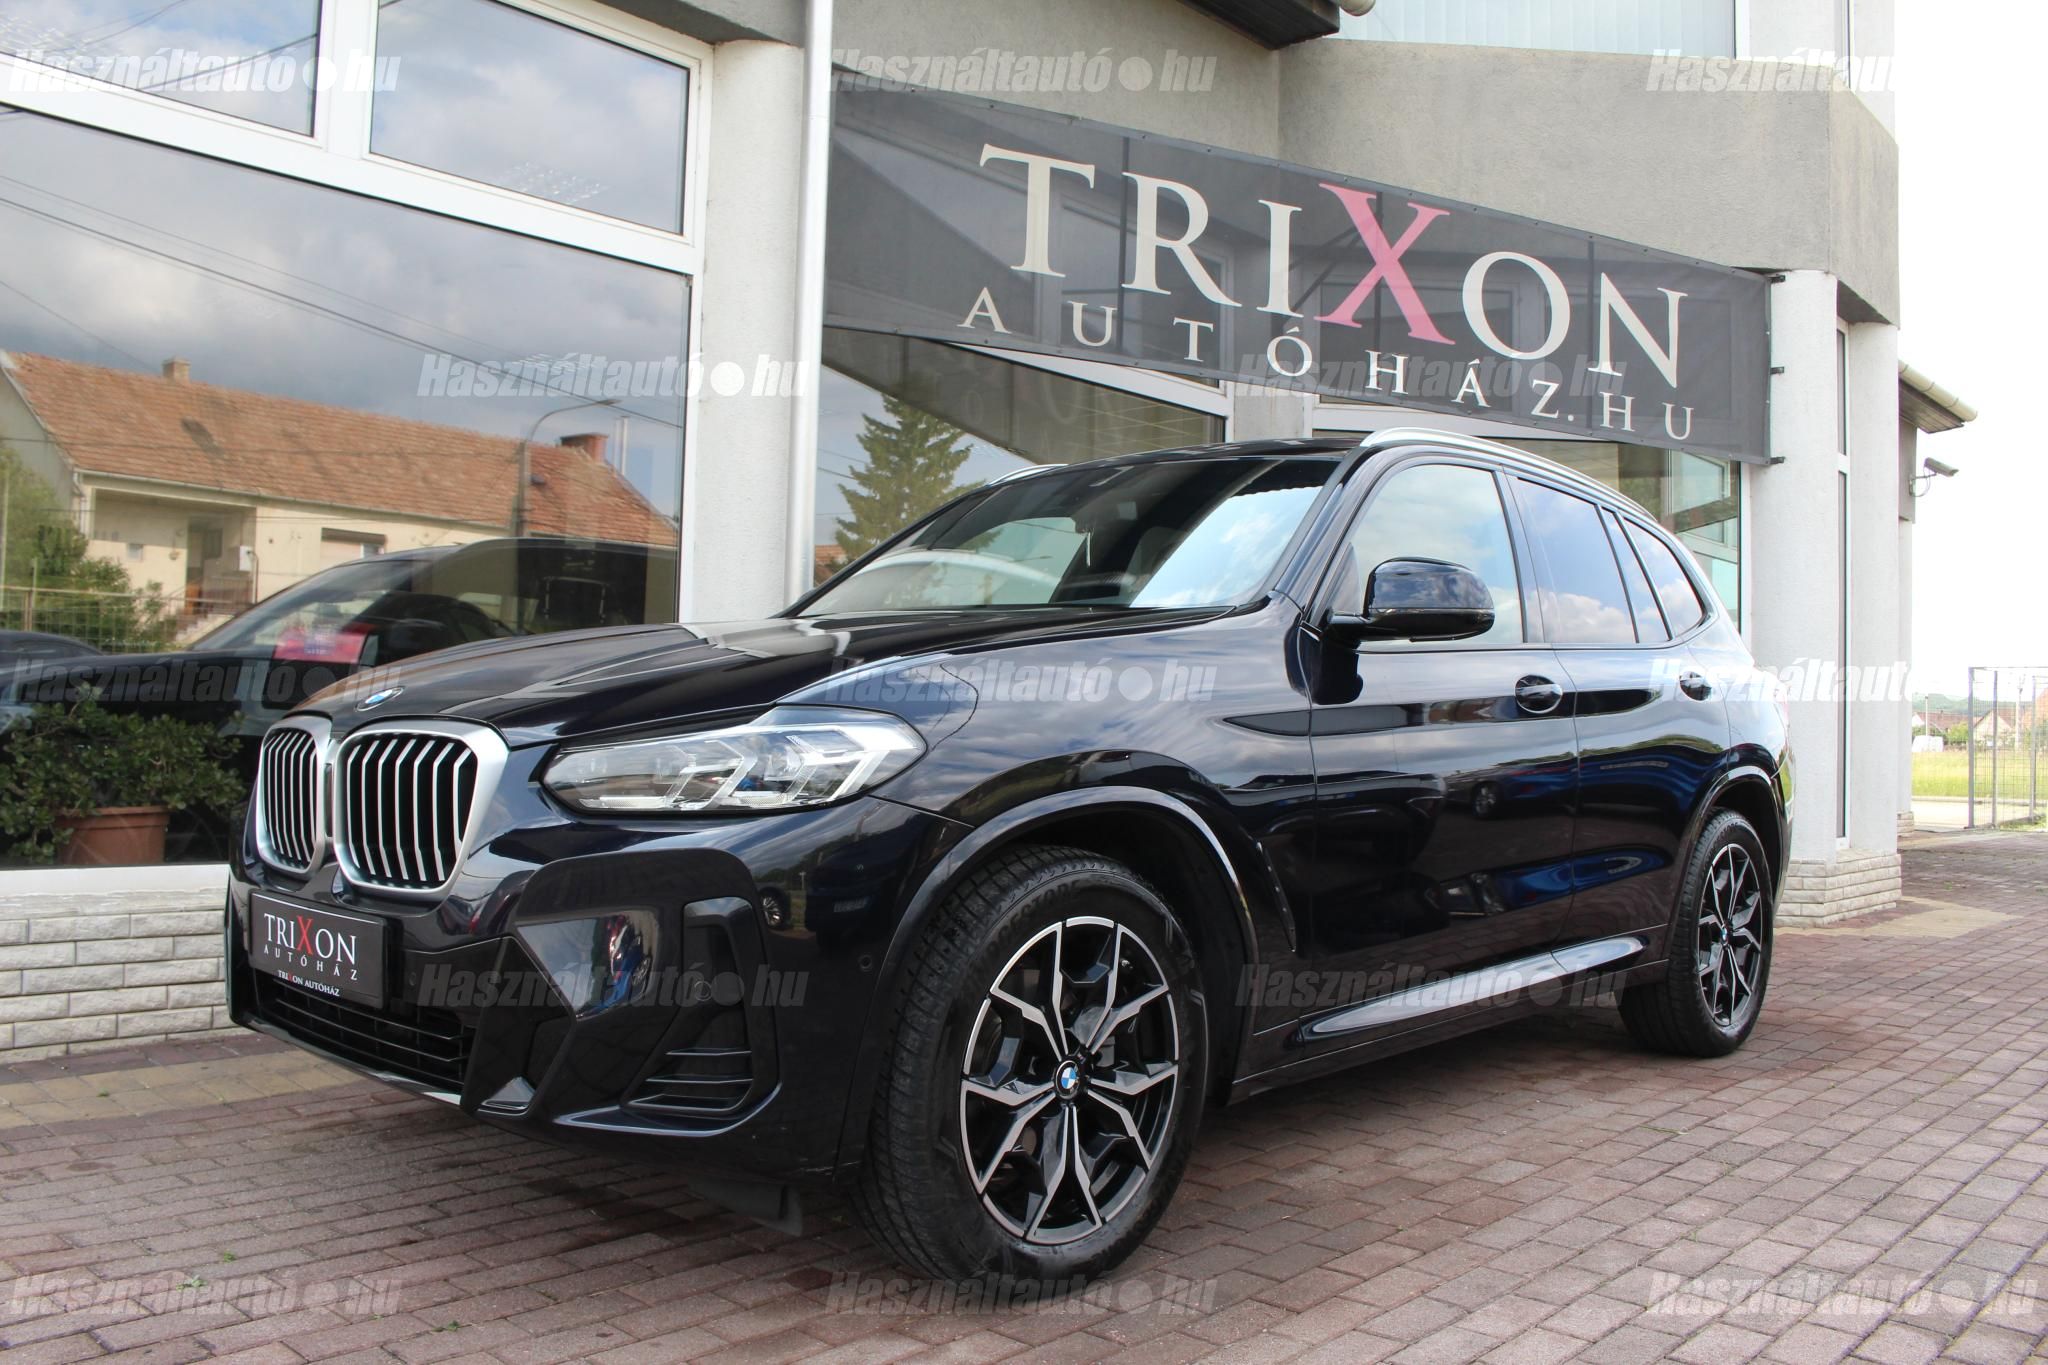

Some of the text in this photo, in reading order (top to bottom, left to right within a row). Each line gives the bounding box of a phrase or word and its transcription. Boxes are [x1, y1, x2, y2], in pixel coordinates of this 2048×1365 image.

[980, 143, 1690, 389] TRIXON
[264, 913, 357, 965] TRIXON
[264, 944, 358, 981] AUTÓHÁZ
